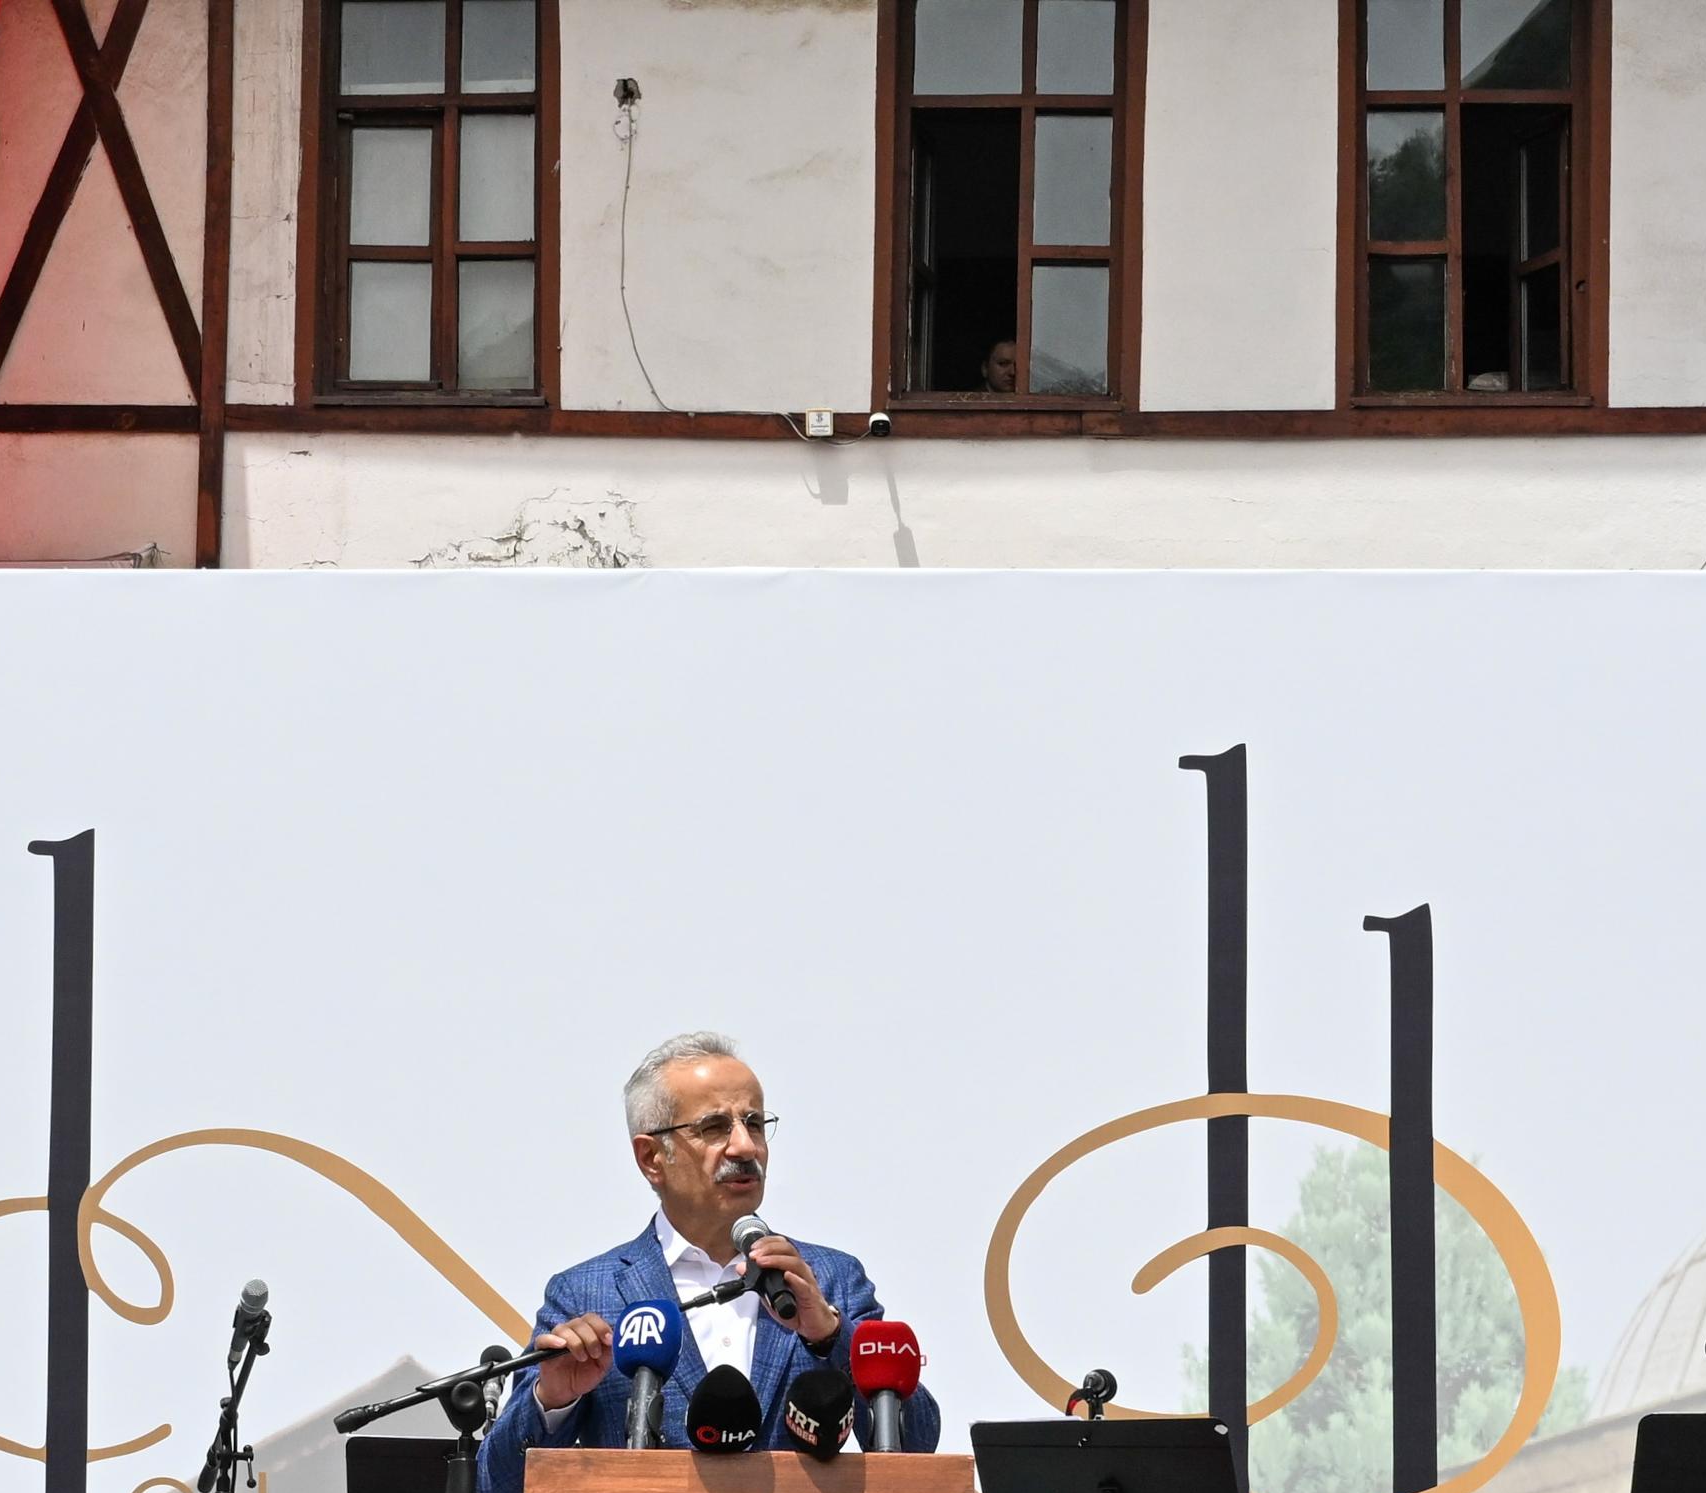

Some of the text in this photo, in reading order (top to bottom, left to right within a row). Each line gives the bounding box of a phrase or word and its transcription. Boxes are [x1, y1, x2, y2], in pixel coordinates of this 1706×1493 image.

[618, 1315, 663, 1348] AA
[859, 1341, 917, 1357] DHA
[788, 1401, 820, 1433] TRT
[721, 1428, 756, 1443] İHA
